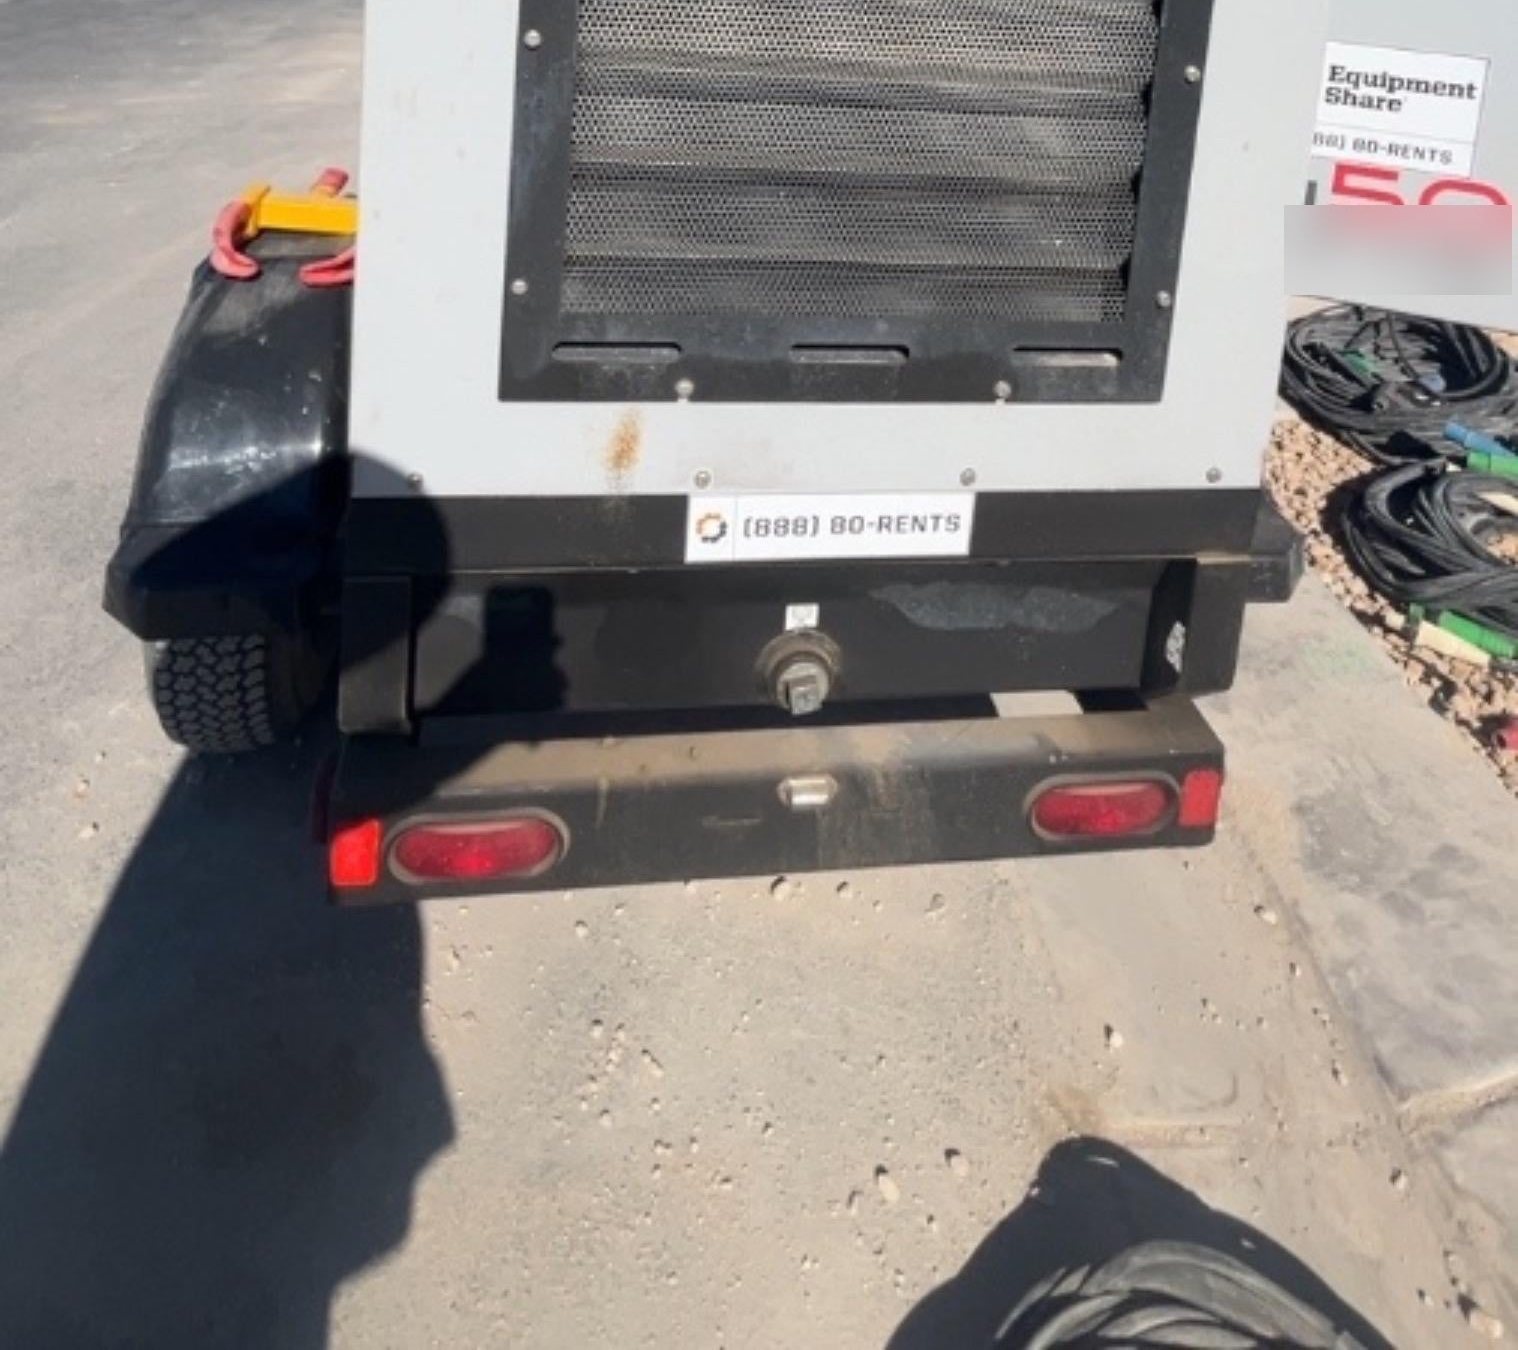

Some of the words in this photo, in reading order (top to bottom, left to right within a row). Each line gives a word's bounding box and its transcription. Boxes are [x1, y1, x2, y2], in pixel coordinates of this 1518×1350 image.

[1328, 64, 1478, 99] Equipment
[1325, 86, 1403, 112] Share
[1352, 138, 1453, 165] 80-RENTS
[743, 515, 820, 539] (888)
[830, 513, 961, 536] 80-RENTS
